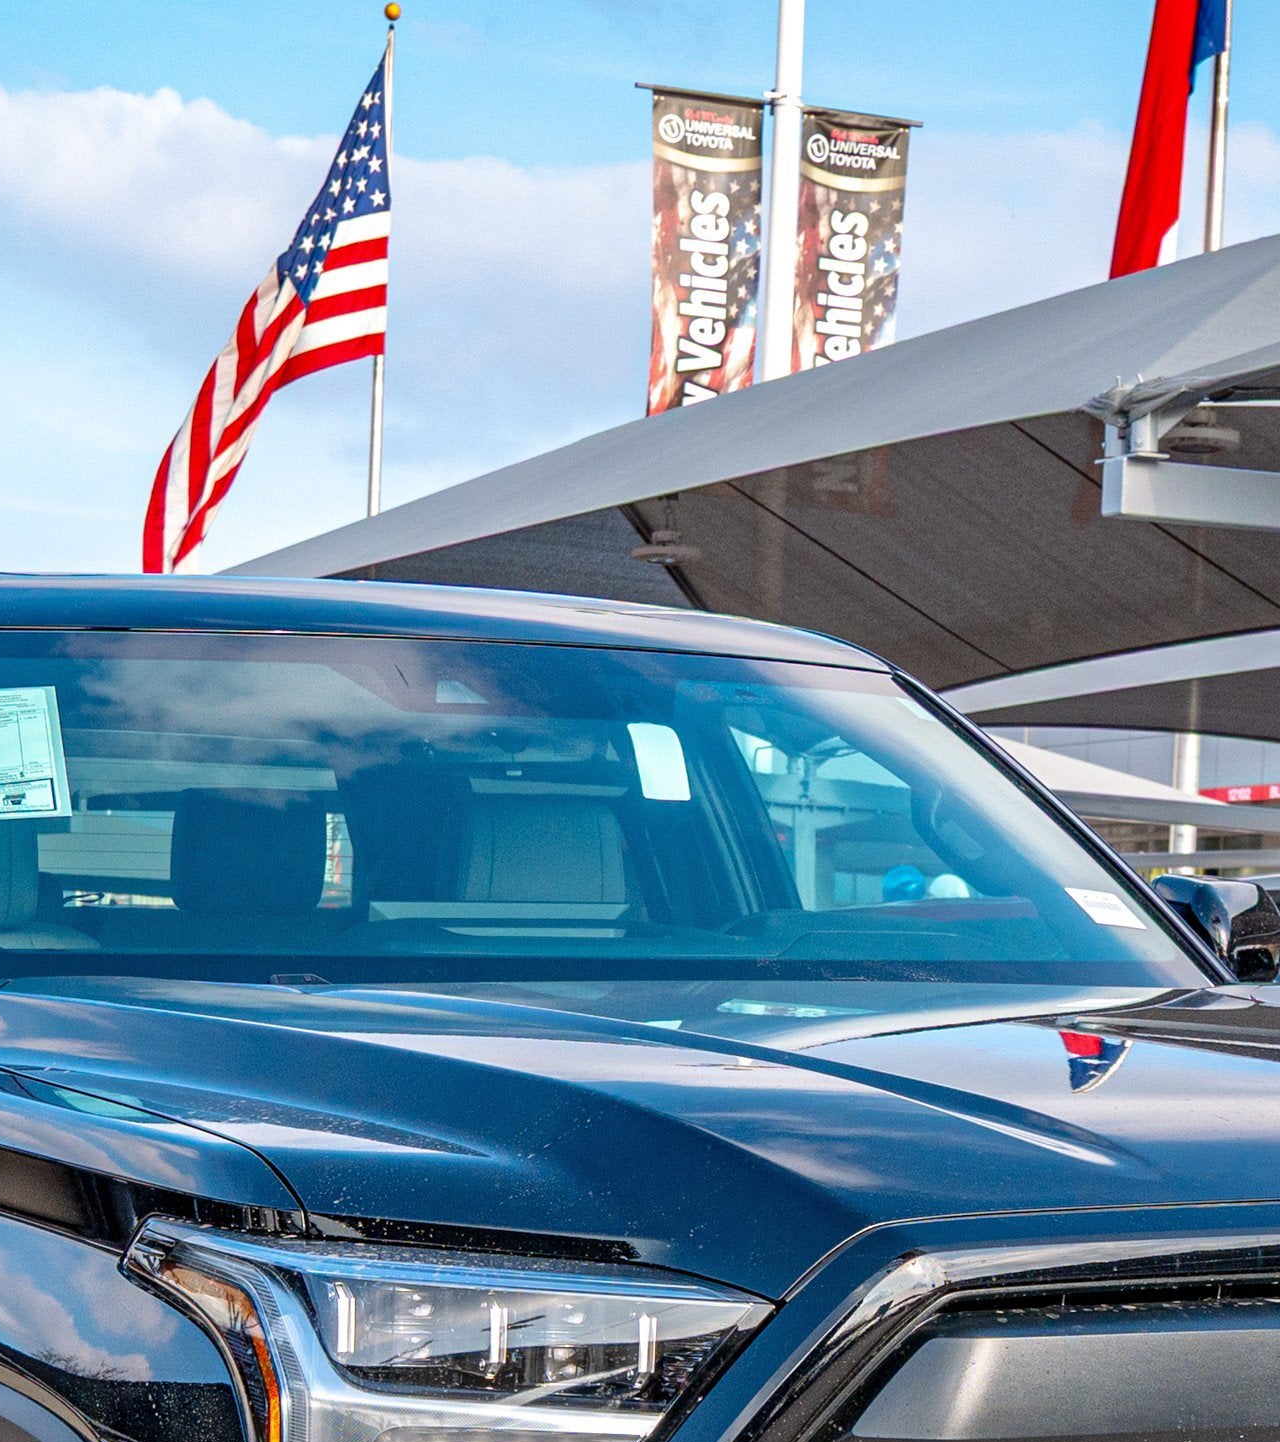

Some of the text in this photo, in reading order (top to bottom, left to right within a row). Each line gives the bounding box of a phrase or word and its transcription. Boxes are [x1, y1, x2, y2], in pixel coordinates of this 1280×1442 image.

[685, 119, 757, 140] UNIVERSAL
[685, 132, 734, 150] TOYOTA
[829, 139, 902, 159] UNIVERSAL
[828, 152, 877, 170] TOYOTA
[676, 190, 731, 373] Vehicles
[814, 209, 869, 368] ehicles
